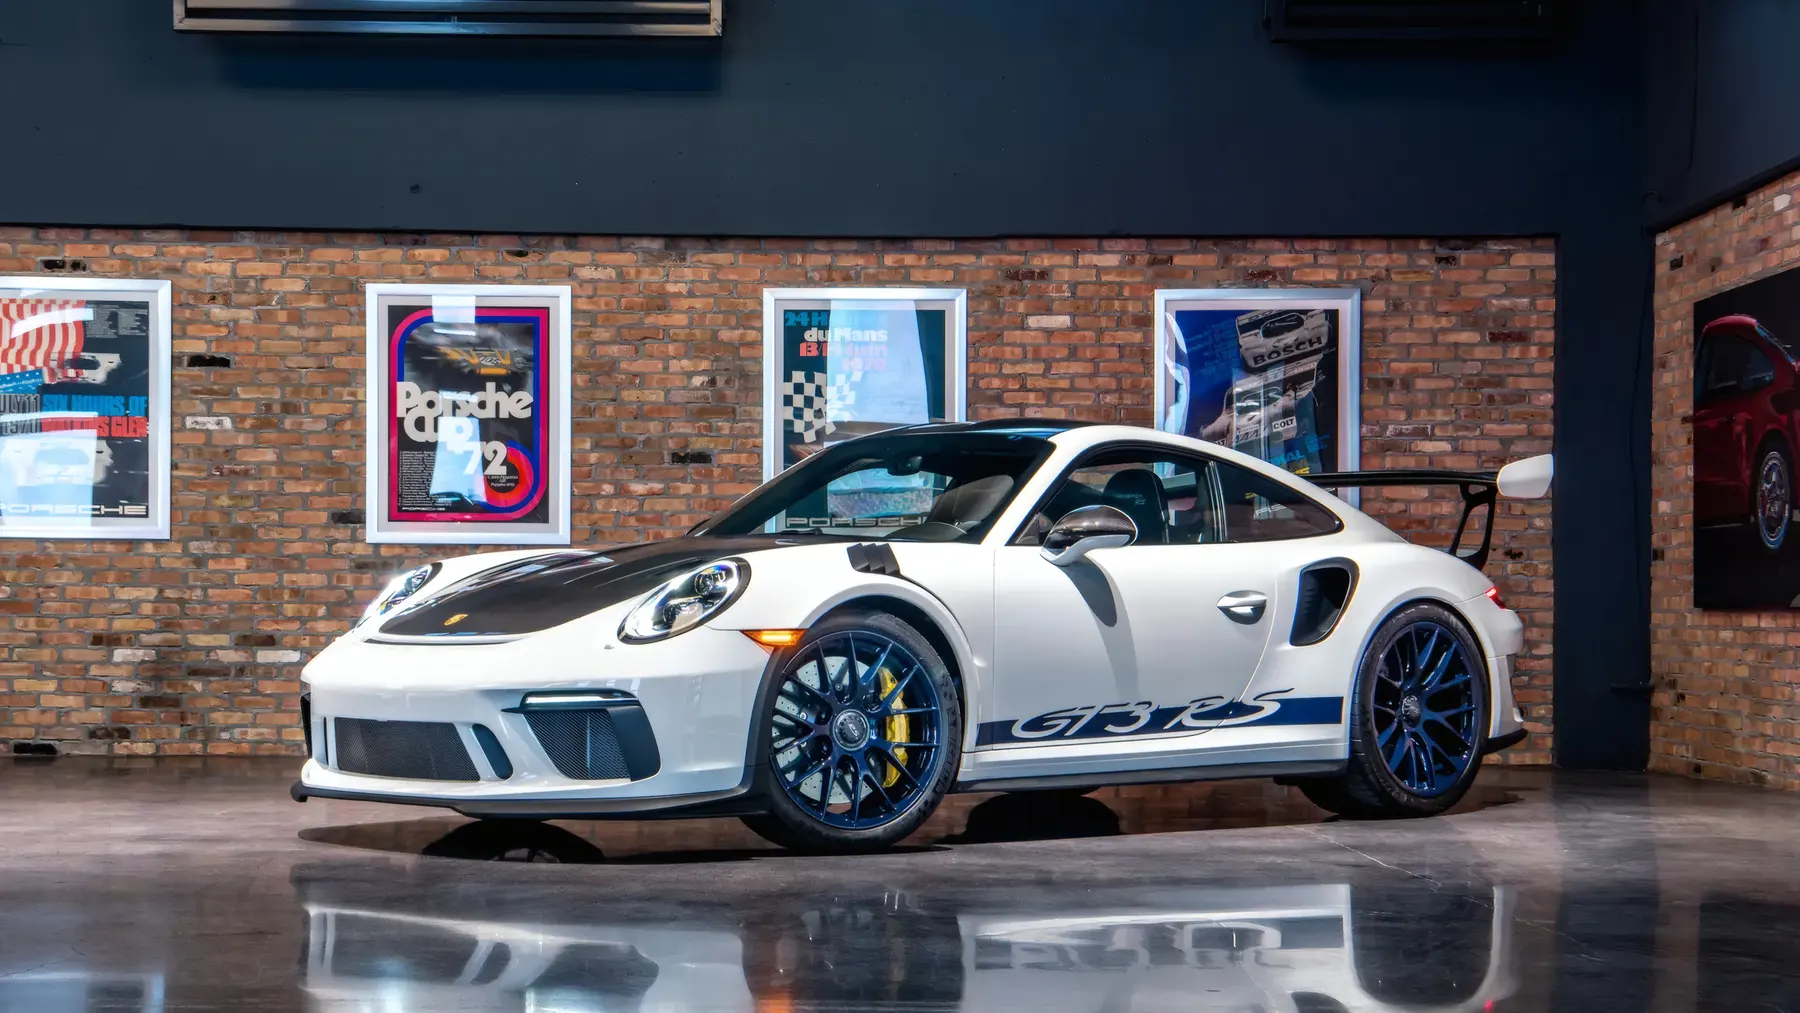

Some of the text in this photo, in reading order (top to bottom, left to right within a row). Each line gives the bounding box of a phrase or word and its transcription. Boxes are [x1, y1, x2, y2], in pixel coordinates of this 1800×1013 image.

[804, 327, 888, 341] du Mans
[1253, 336, 1322, 365] BOSCH
[397, 382, 533, 418] Porsche
[1273, 418, 1295, 430] COLT
[786, 517, 927, 527] PORSCH
[1011, 688, 1295, 738] GT3 RS
